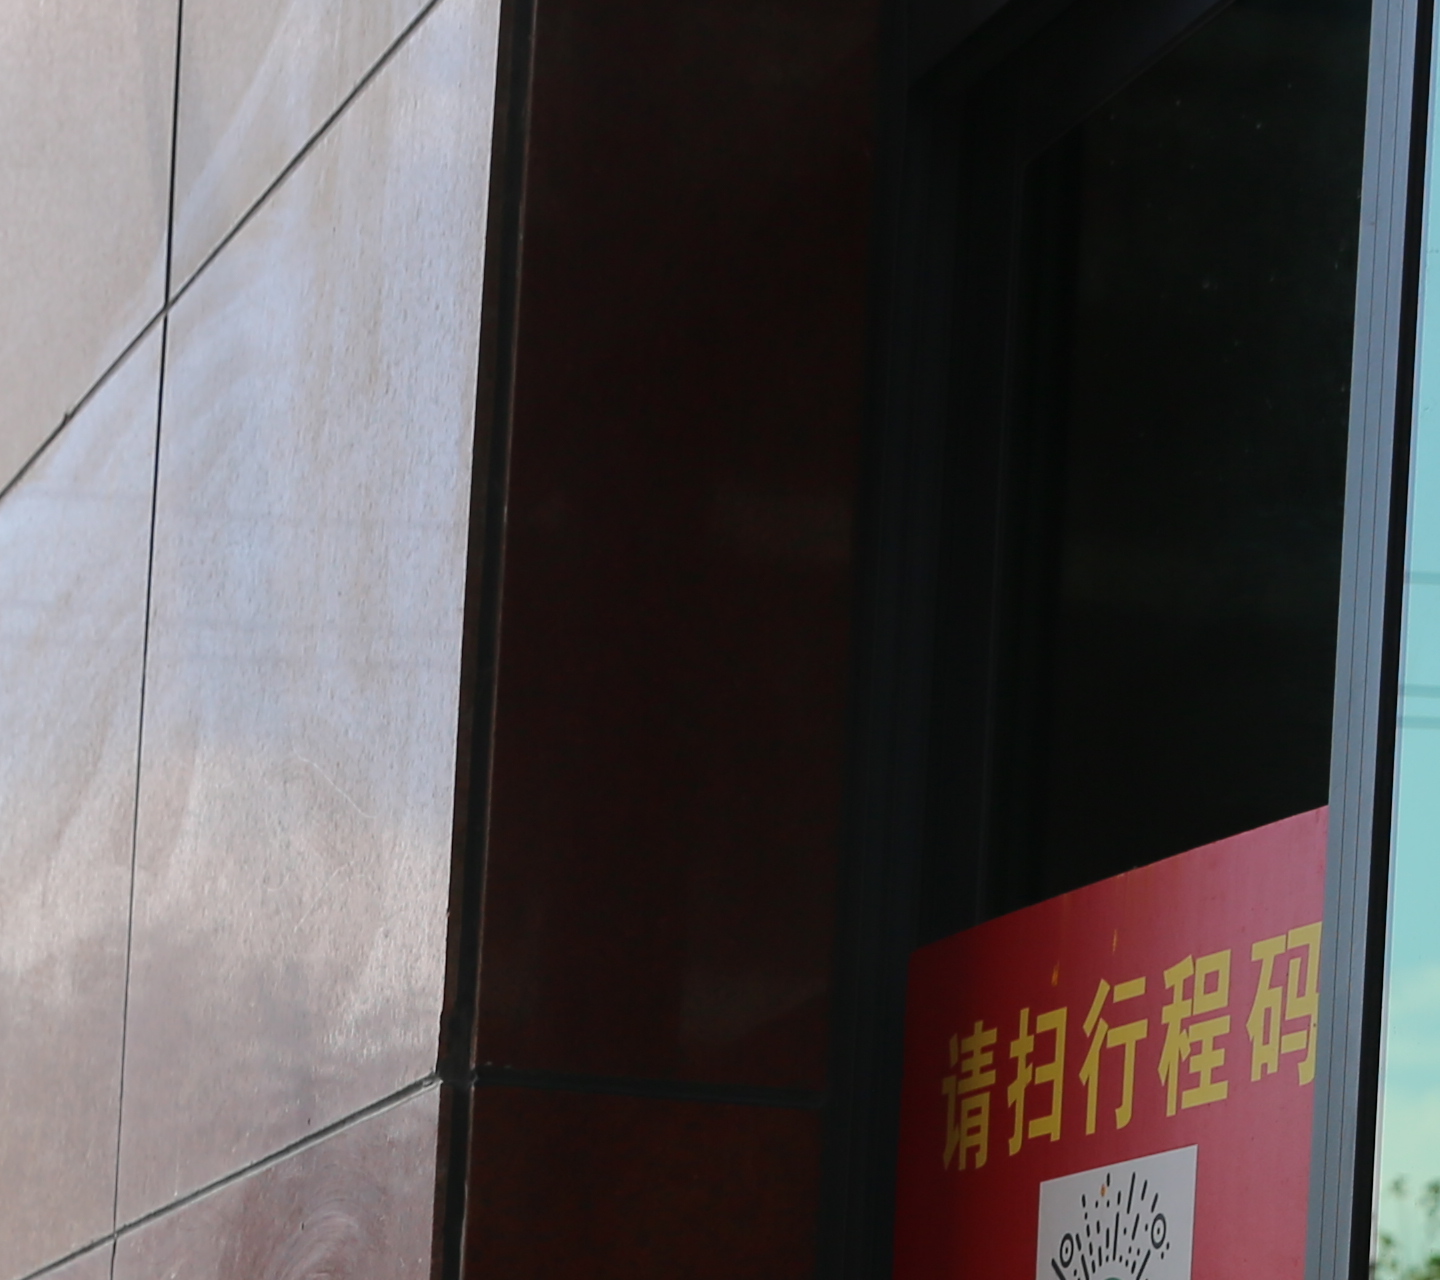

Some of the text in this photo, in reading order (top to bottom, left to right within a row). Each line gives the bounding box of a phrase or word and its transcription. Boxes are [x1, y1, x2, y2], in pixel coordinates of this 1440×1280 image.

[942, 921, 1322, 1171] 请扫行程码
